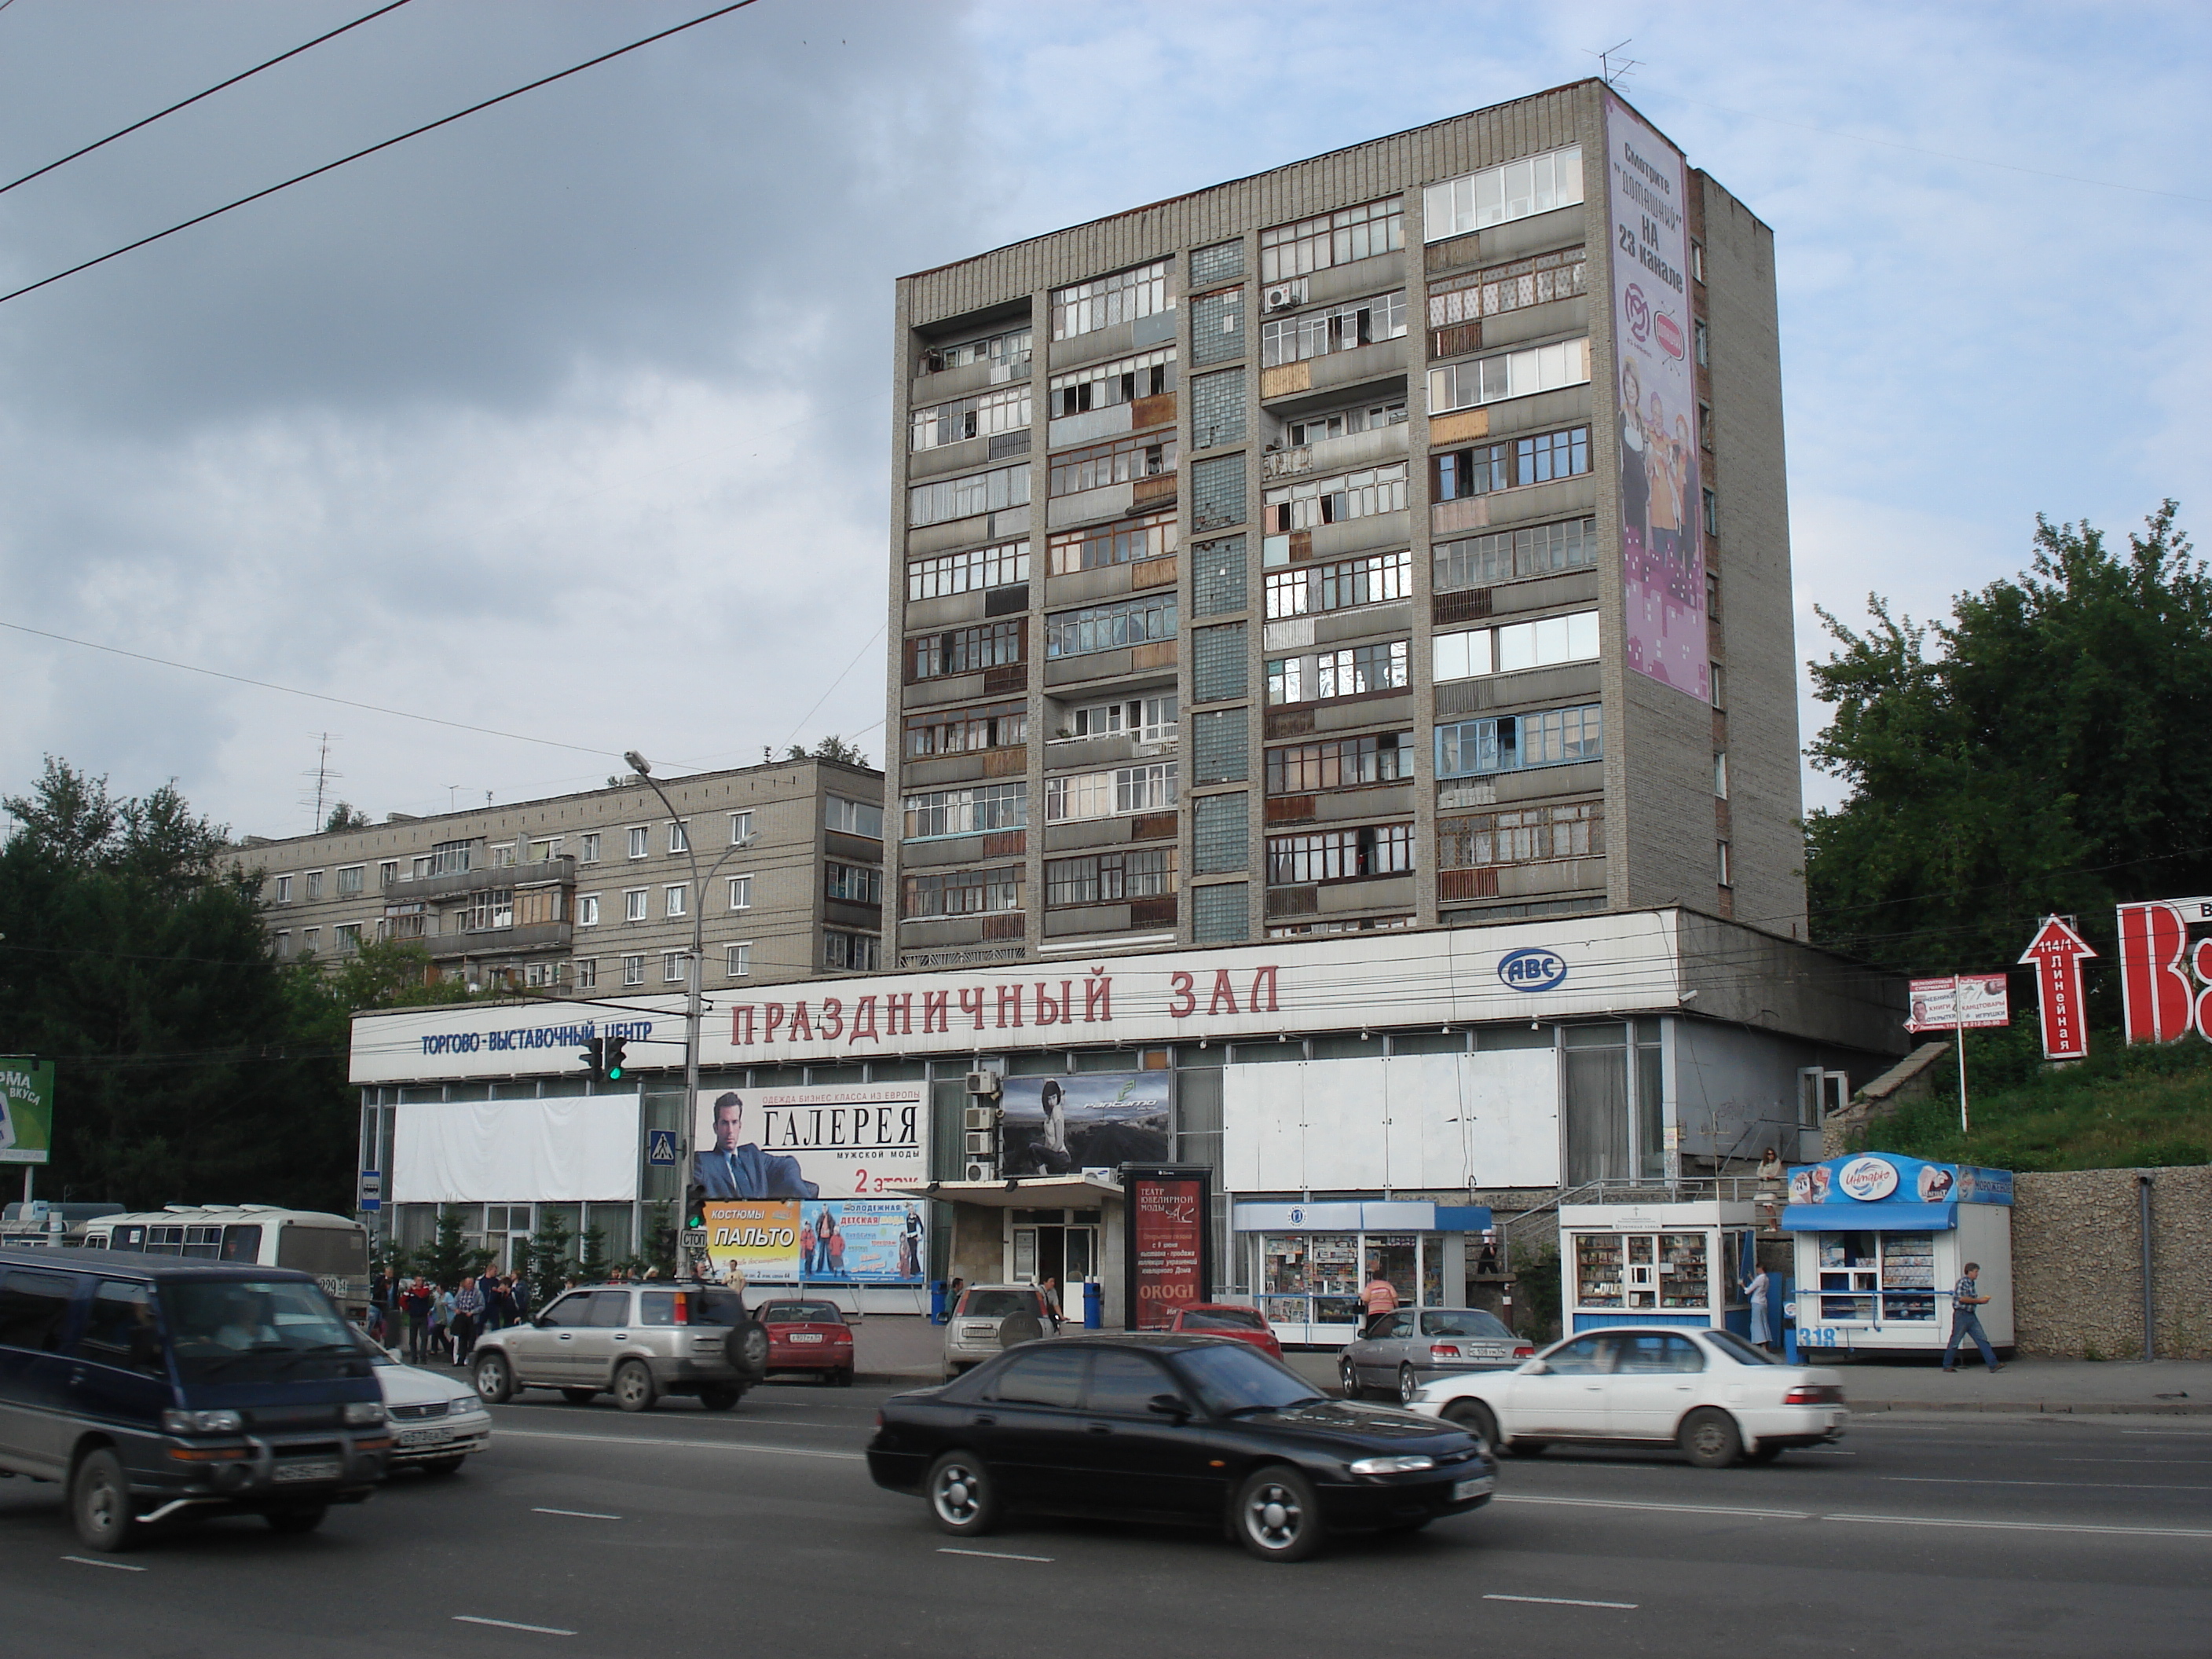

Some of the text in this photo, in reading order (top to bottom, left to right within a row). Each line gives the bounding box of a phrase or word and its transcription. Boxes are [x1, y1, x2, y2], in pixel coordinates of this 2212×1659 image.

[1624, 142, 1670, 195] Смотрите
[1642, 214, 1659, 251] НА
[1619, 223, 1683, 295] 23 канале
[2038, 939, 2072, 953] 114/1
[731, 965, 1280, 1045] ПРАЗДНИЧНЫЙ ЗАЛ
[2051, 954, 2070, 1050] Линейная
[9, 1087, 41, 1106] ВКУСА
[799, 1094, 832, 1103] БИЗНЕС
[834, 1093, 867, 1101] КЛАССА
[885, 1090, 920, 1099] ЕВРОПЫ
[763, 1106, 918, 1146] ГАЛЕРЕЯ
[837, 1150, 920, 1159] МУЖСКОЙ МОДЫ
[855, 1169, 868, 1193] 2
[1975, 1179, 2012, 1193] МОРОЖЕНОЕ
[712, 1210, 765, 1219] КОСТЮМЫ
[840, 1217, 878, 1225] ДЕТСКАЯ
[683, 1233, 705, 1246] СТОП
[714, 1227, 794, 1247] ПАЛЬТО
[1140, 1284, 1194, 1299] OROGI
[1800, 1328, 1835, 1346] 318
